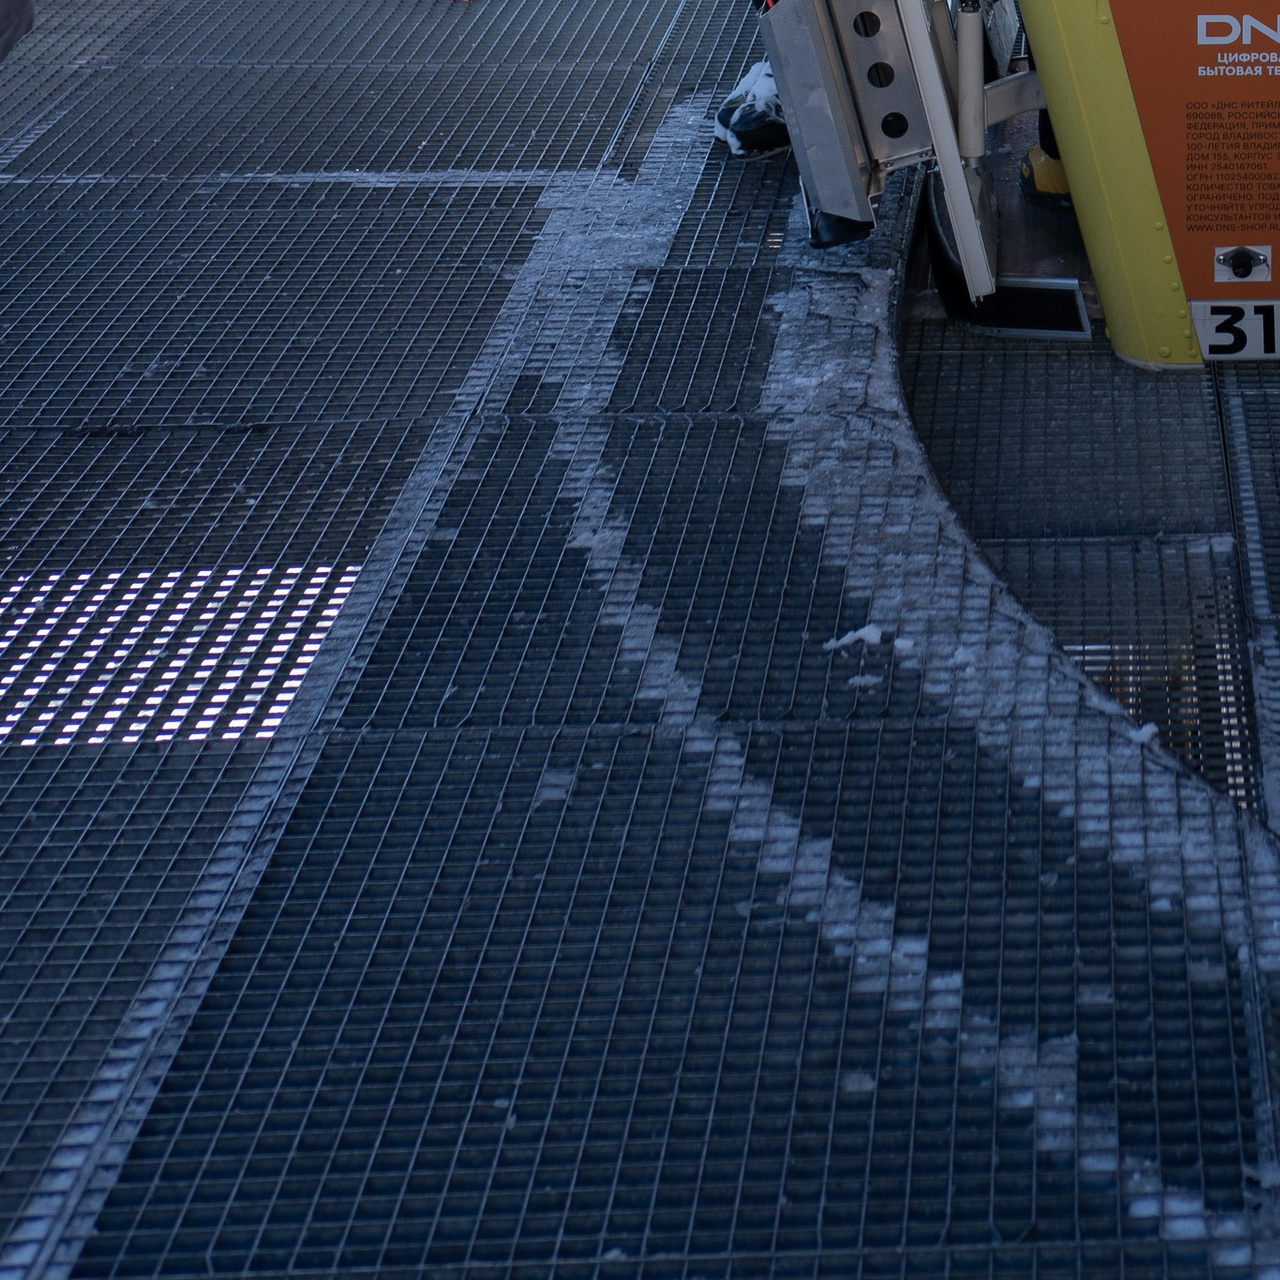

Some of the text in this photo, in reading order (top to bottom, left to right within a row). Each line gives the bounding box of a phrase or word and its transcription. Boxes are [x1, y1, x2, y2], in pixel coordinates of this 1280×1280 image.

[1198, 65, 1263, 77] БЫТОВАЯ
[1211, 101, 1238, 110] «ДНС
[1186, 122, 1249, 131] ФЕДЕРАЦИЯ,
[1186, 132, 1220, 141] ГОРОД
[1187, 142, 1240, 151] 100-ЛЕТИЯ
[1186, 153, 1209, 161] ДОМ
[1213, 153, 1231, 161] 155,
[1234, 152, 1273, 160] КОРПУС
[1186, 163, 1208, 171] ИНН
[1186, 173, 1213, 181] ОГРН
[1186, 183, 1253, 191] КОЛИЧЕСТВО
[1186, 193, 1255, 201] ОГРАНИЧЕНО.
[1186, 203, 1246, 211] УТОЧНЯЙТЕ
[1186, 213, 1271, 222] КОНСУЛЬТАНТОВ
[1208, 304, 1276, 355] 31
